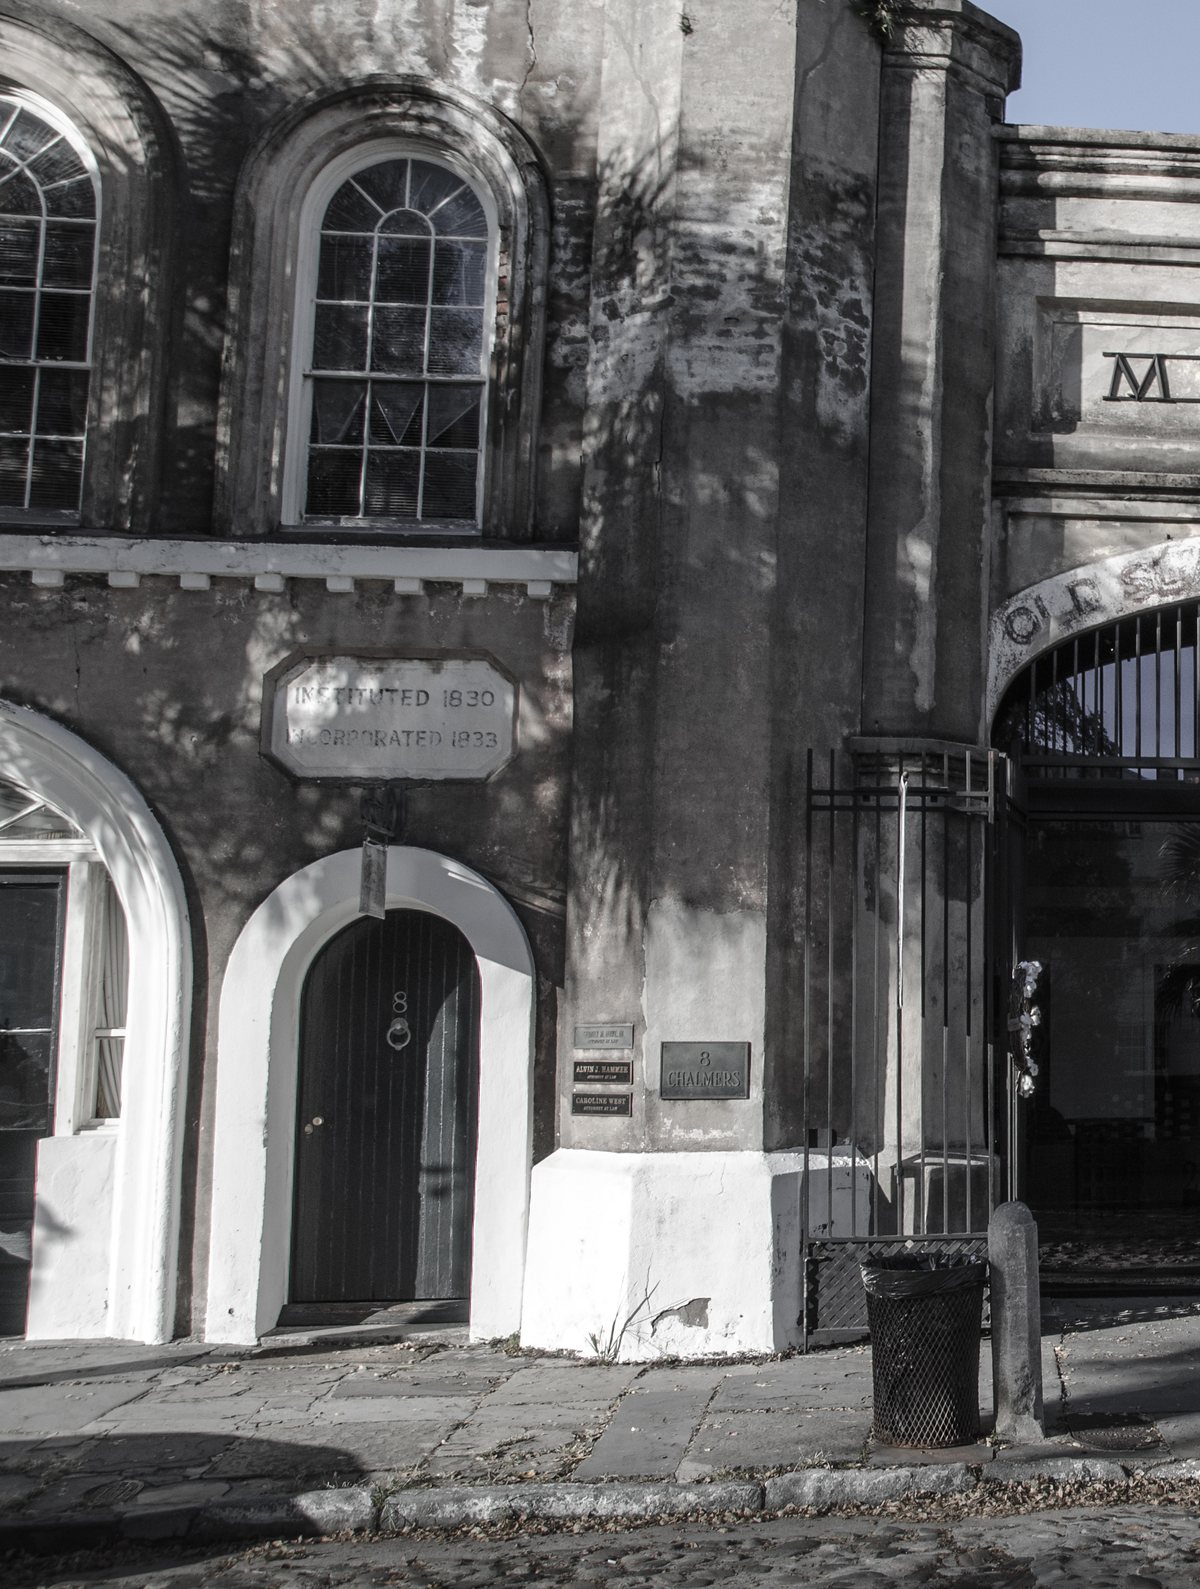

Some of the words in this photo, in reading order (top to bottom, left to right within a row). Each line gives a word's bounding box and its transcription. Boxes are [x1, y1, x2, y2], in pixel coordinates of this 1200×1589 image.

[1004, 576, 1103, 646] OLD
[295, 686, 430, 707] INSTITUTED
[443, 689, 495, 708] 1830
[286, 728, 442, 749] INCORPORATED
[452, 731, 498, 749] 1833
[392, 991, 408, 1013] 8
[700, 1051, 712, 1067] 8
[667, 1070, 742, 1088] CHALMERS
[608, 1097, 627, 1105] WEST
